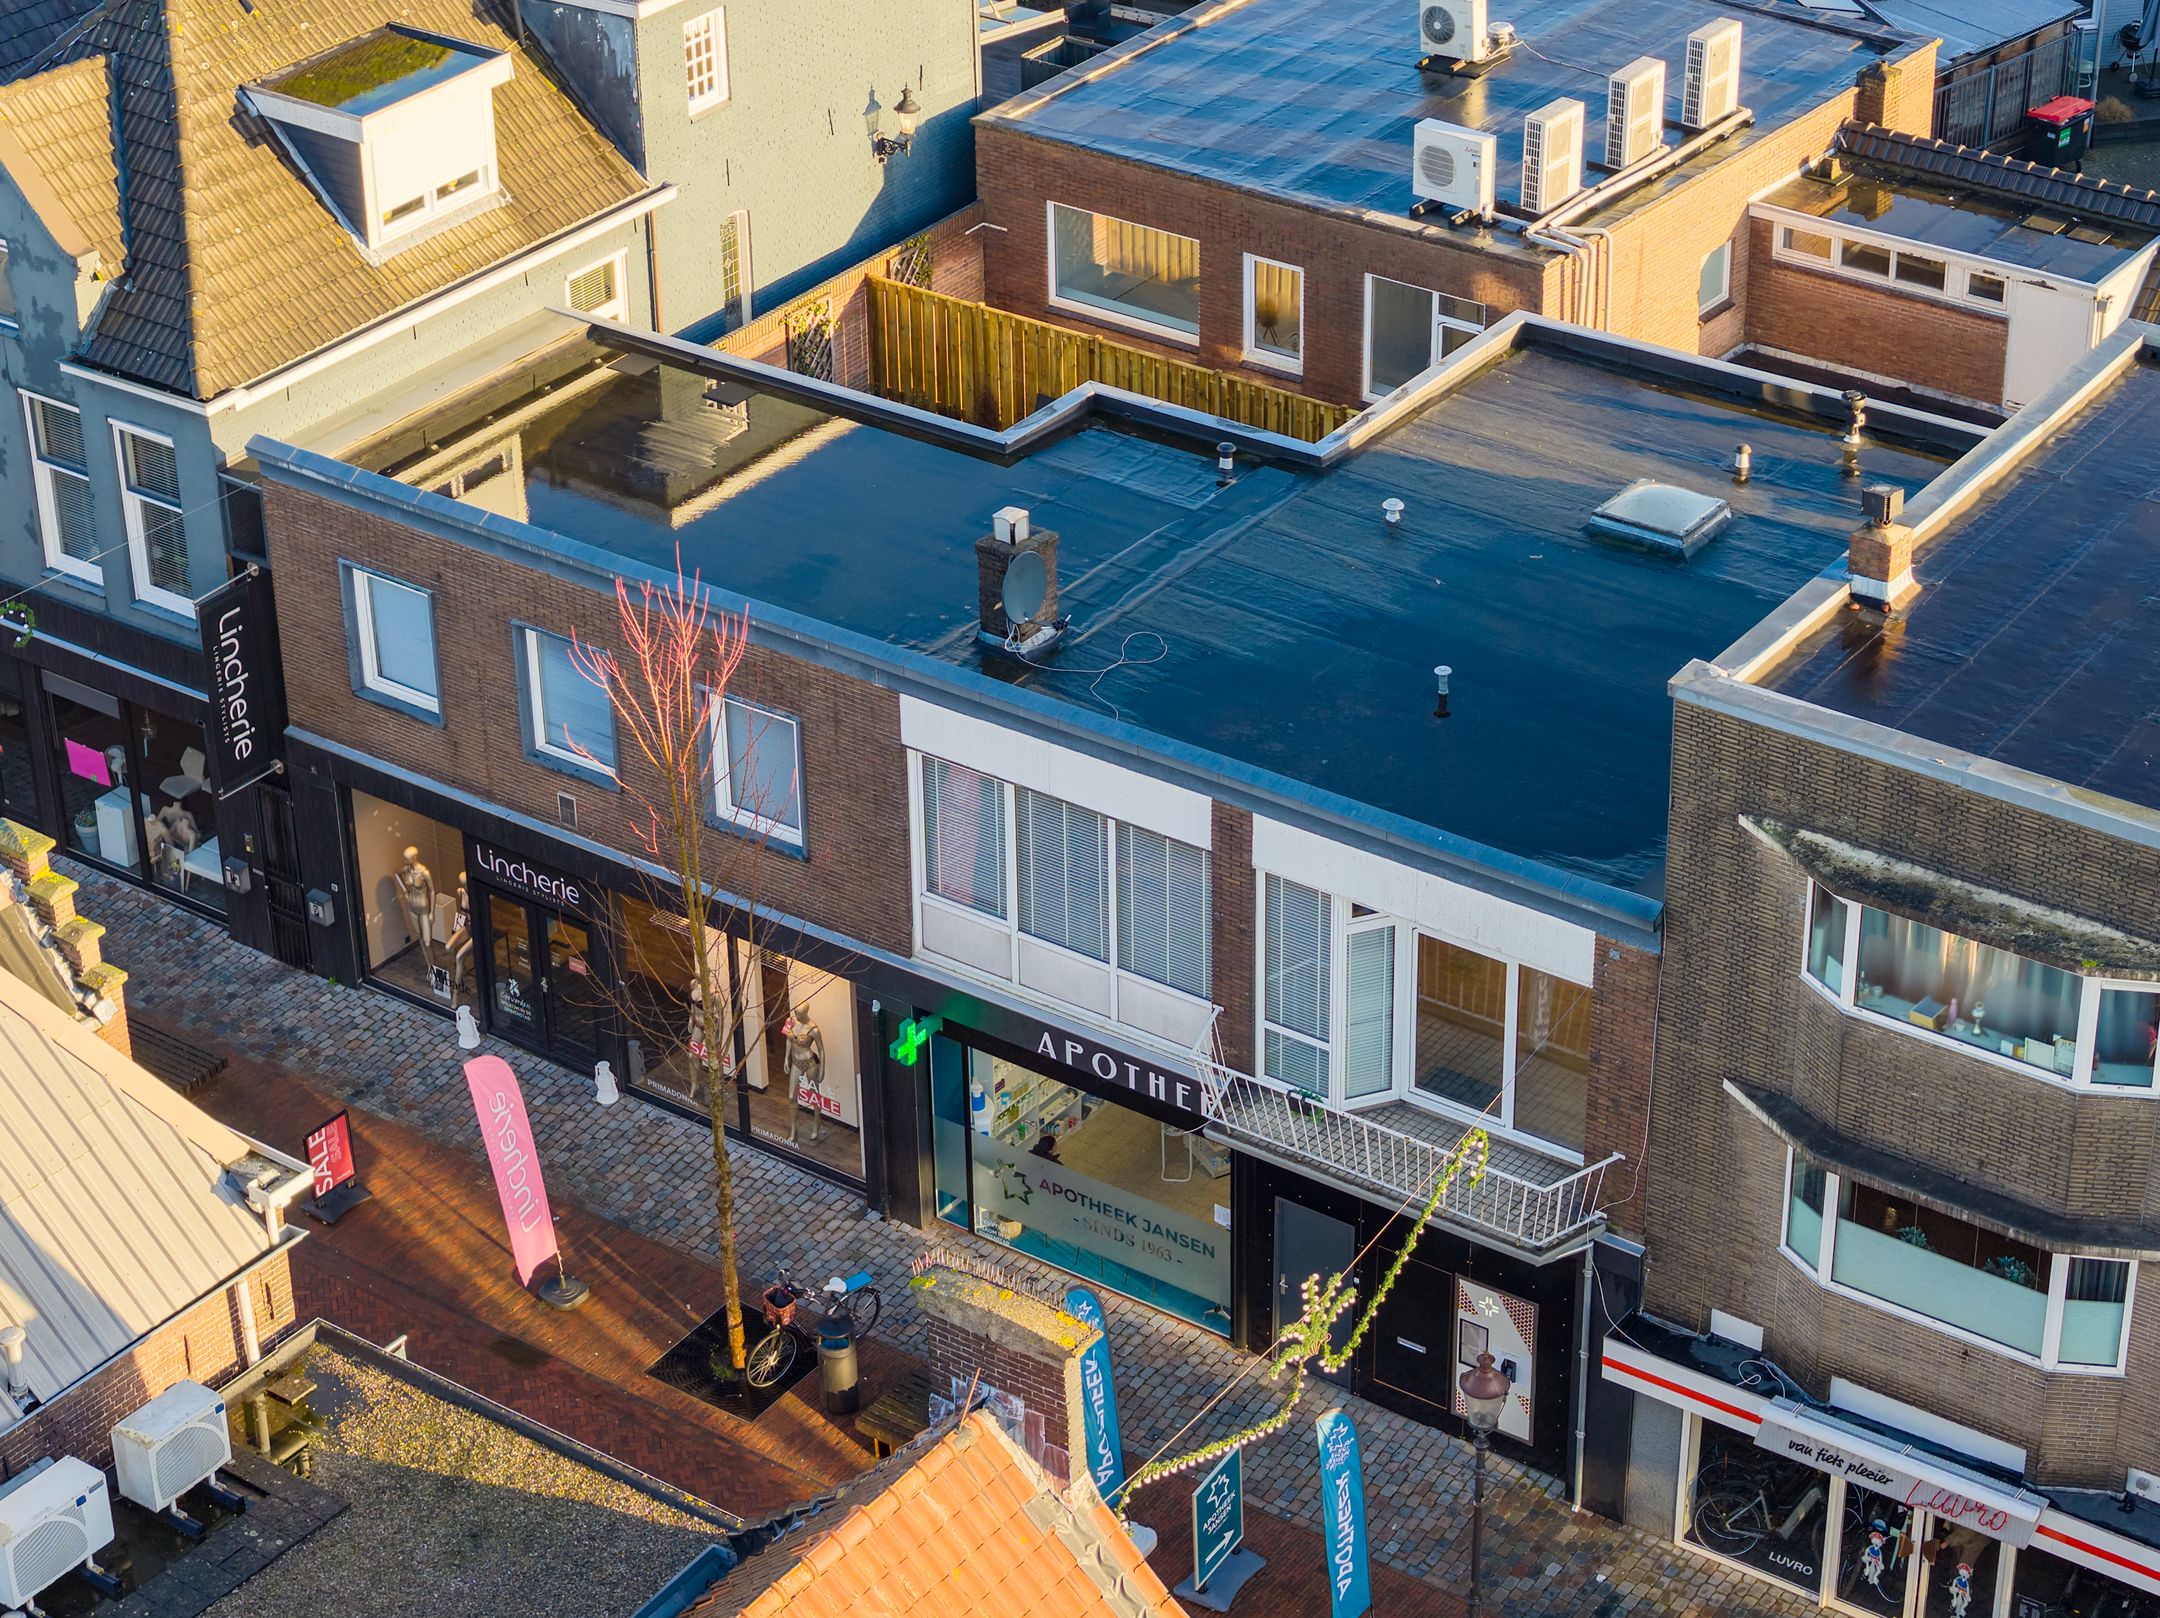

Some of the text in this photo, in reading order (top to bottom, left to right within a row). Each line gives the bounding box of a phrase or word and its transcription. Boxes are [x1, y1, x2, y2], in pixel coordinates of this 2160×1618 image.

[212, 645, 230, 744] LINGERIE STYLISTS
[219, 606, 256, 760] Lincherie
[476, 844, 580, 904] Lincherie
[690, 1041, 731, 1068] SAE
[798, 1088, 840, 1116] SALE
[751, 1125, 800, 1150] PRIMADONNA
[308, 1127, 333, 1197] SALE
[1039, 1178, 1215, 1259] APOTHEEK JANSEN
[1083, 1216, 1135, 1247] SINDS
[1141, 1240, 1173, 1263] 1963
[1788, 1440, 1894, 1485] van fiets plezier
[1768, 1551, 1813, 1575] LUVRO
